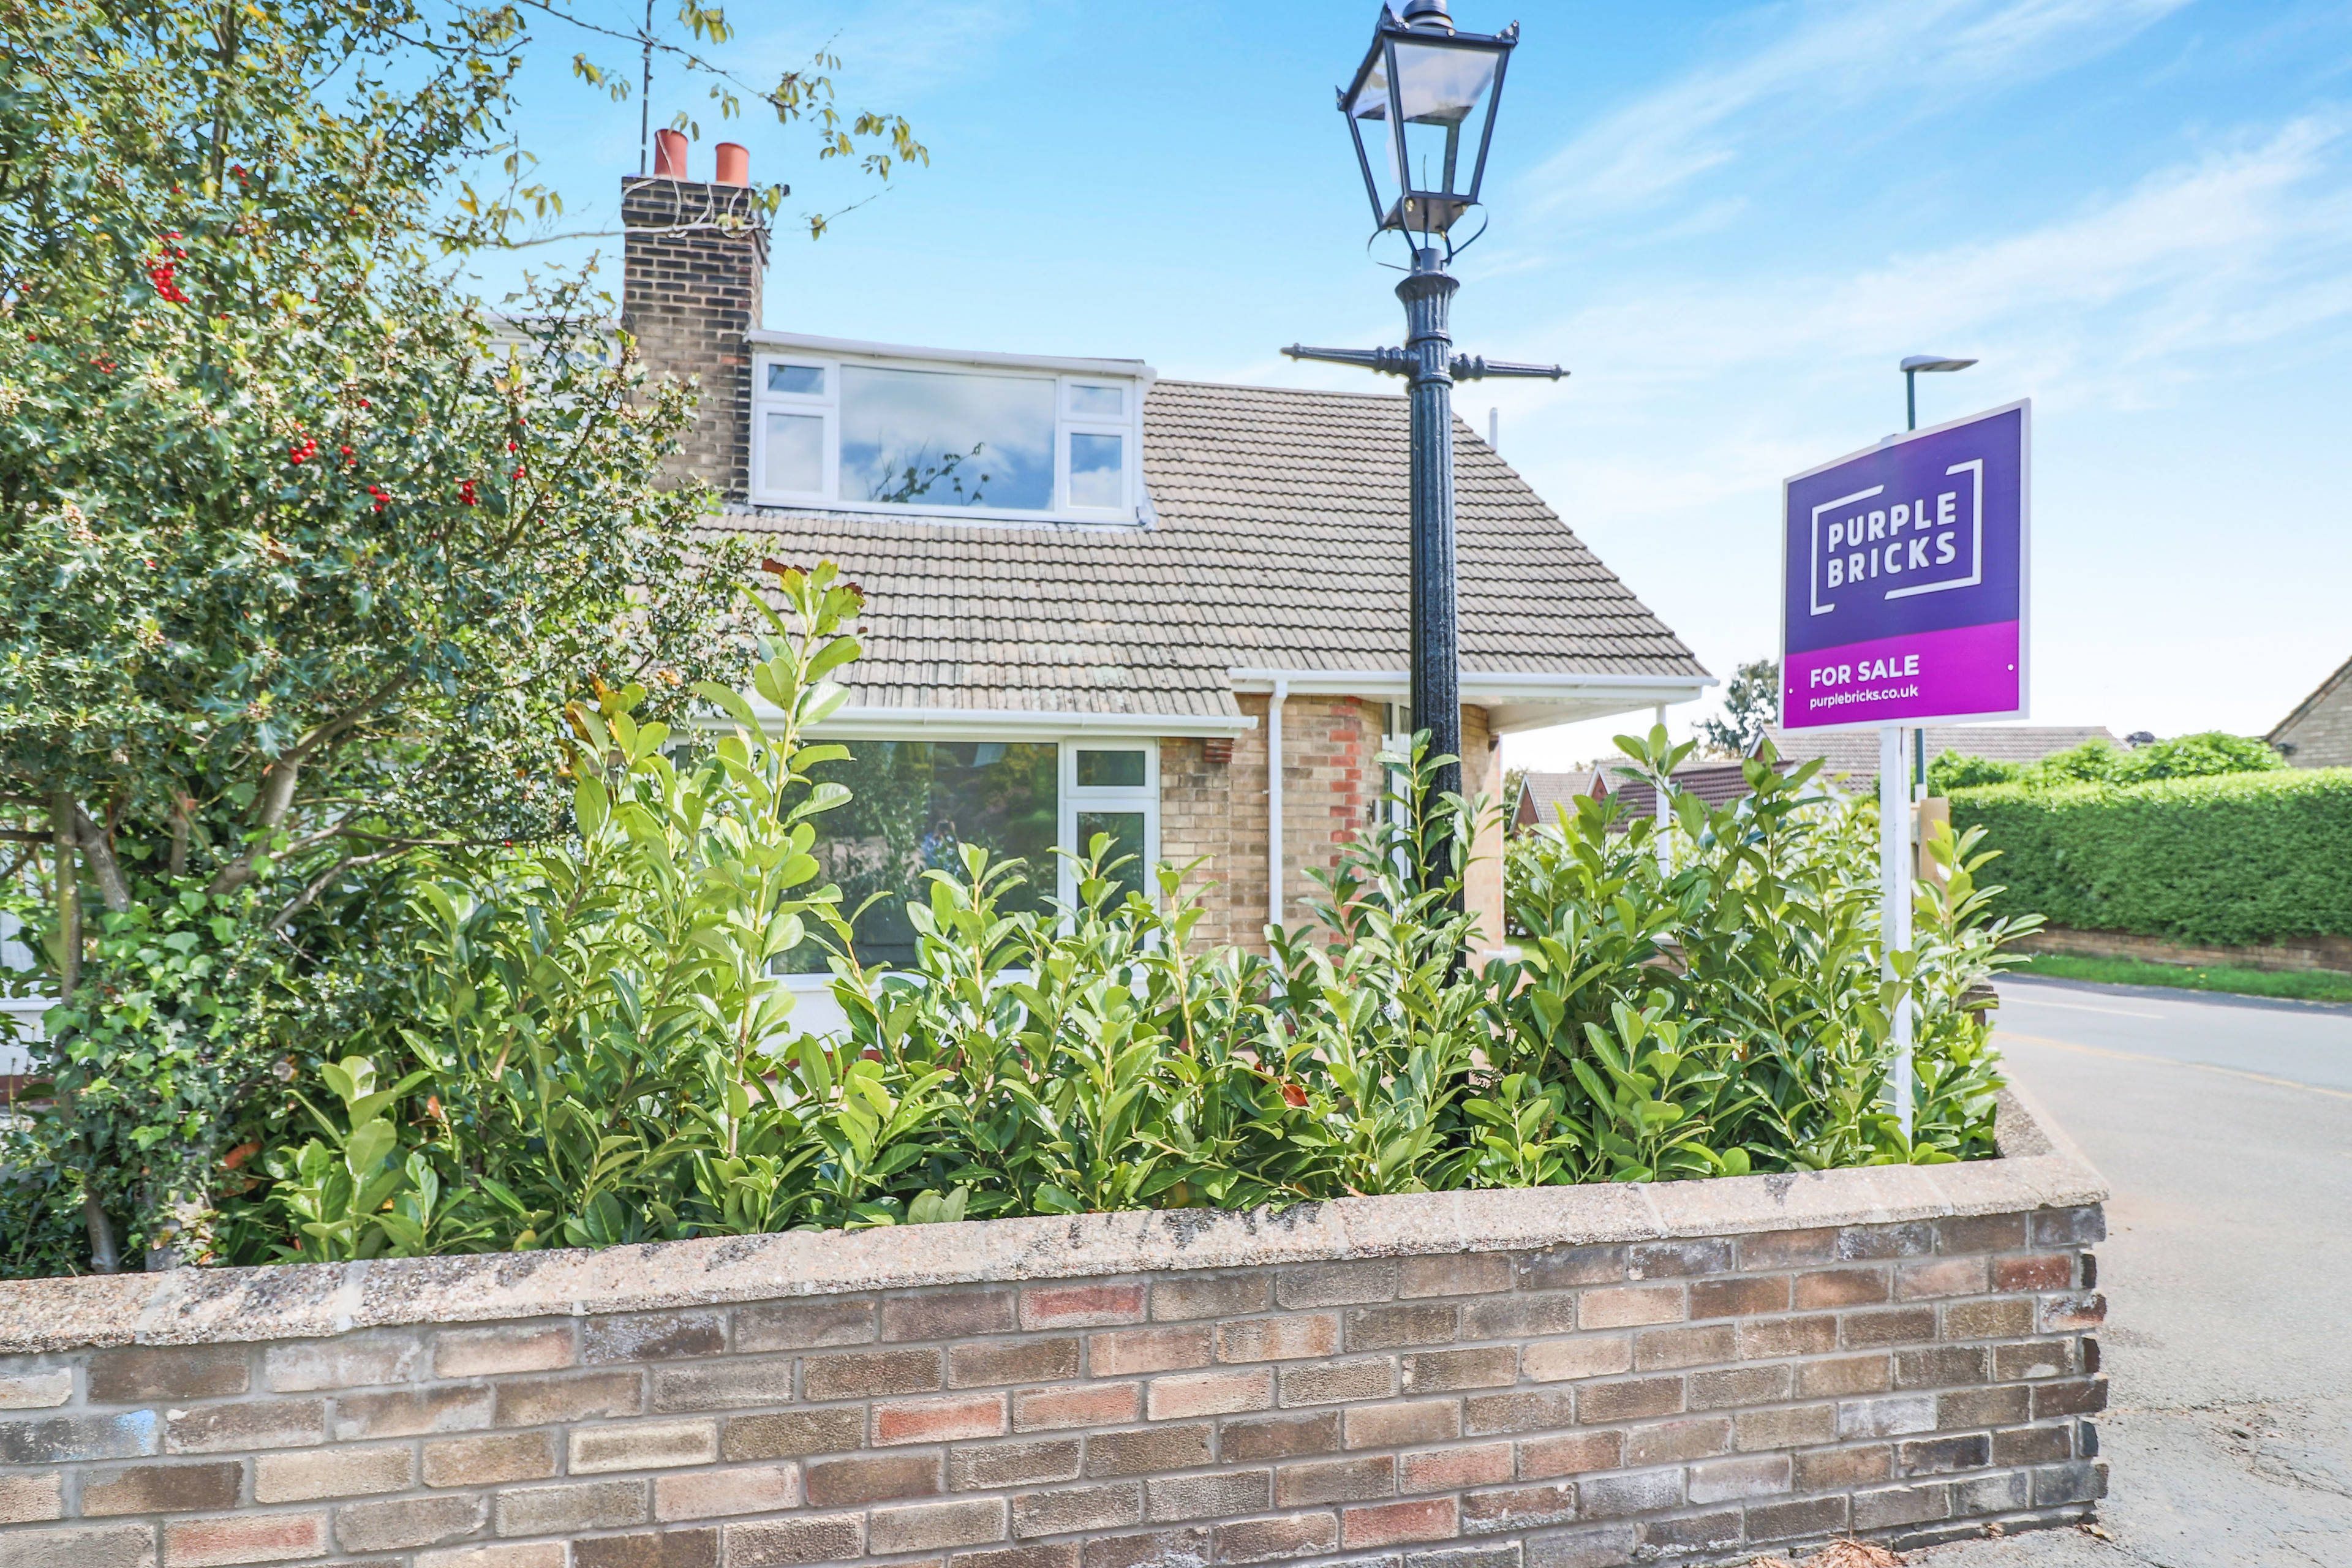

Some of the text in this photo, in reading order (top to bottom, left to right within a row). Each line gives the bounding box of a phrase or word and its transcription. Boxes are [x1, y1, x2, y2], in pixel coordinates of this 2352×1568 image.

[1828, 491, 1956, 553] PURPLE
[1827, 531, 1956, 589] BRICKS
[1809, 654, 1920, 688] FOR SALE
[1809, 684, 1919, 710] purplebricks.co.uk
